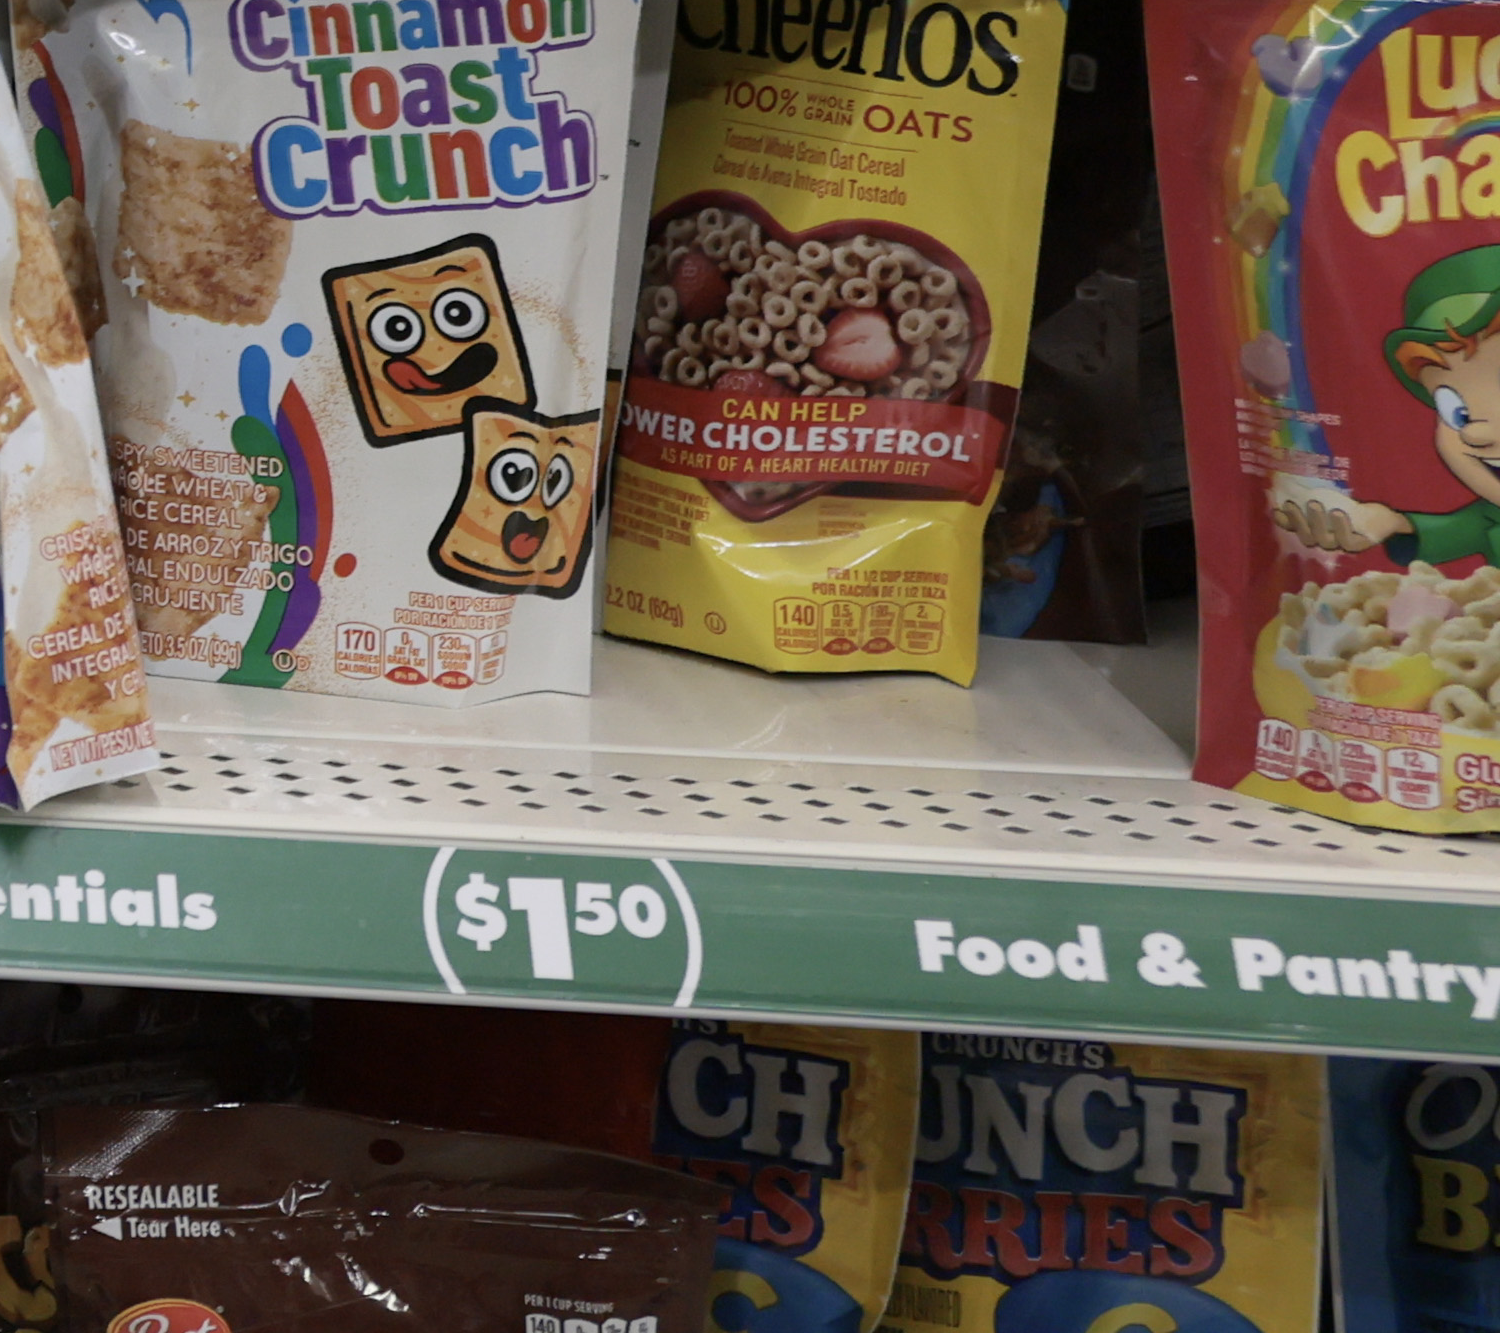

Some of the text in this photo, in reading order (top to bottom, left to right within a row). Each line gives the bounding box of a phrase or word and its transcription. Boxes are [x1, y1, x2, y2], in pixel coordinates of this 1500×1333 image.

[307, 46, 536, 131] Toast
[862, 103, 975, 144] OATS
[266, 99, 593, 209] Crunch
[722, 398, 868, 423] CAN HELP
[621, 404, 972, 463] OWER CHOLESTEROL
[660, 447, 930, 478] AS PART OF A HEART HEALTHY DIET
[778, 603, 815, 627] 140
[914, 920, 1105, 985] Food
[1138, 930, 1209, 991] &
[931, 1032, 1106, 1070] CRUNCH'S
[918, 1066, 1241, 1195] UNCH
[87, 1183, 220, 1212] RESEALABLE
[126, 1215, 221, 1240] Tear Here
[910, 1191, 1227, 1279] RRIES
